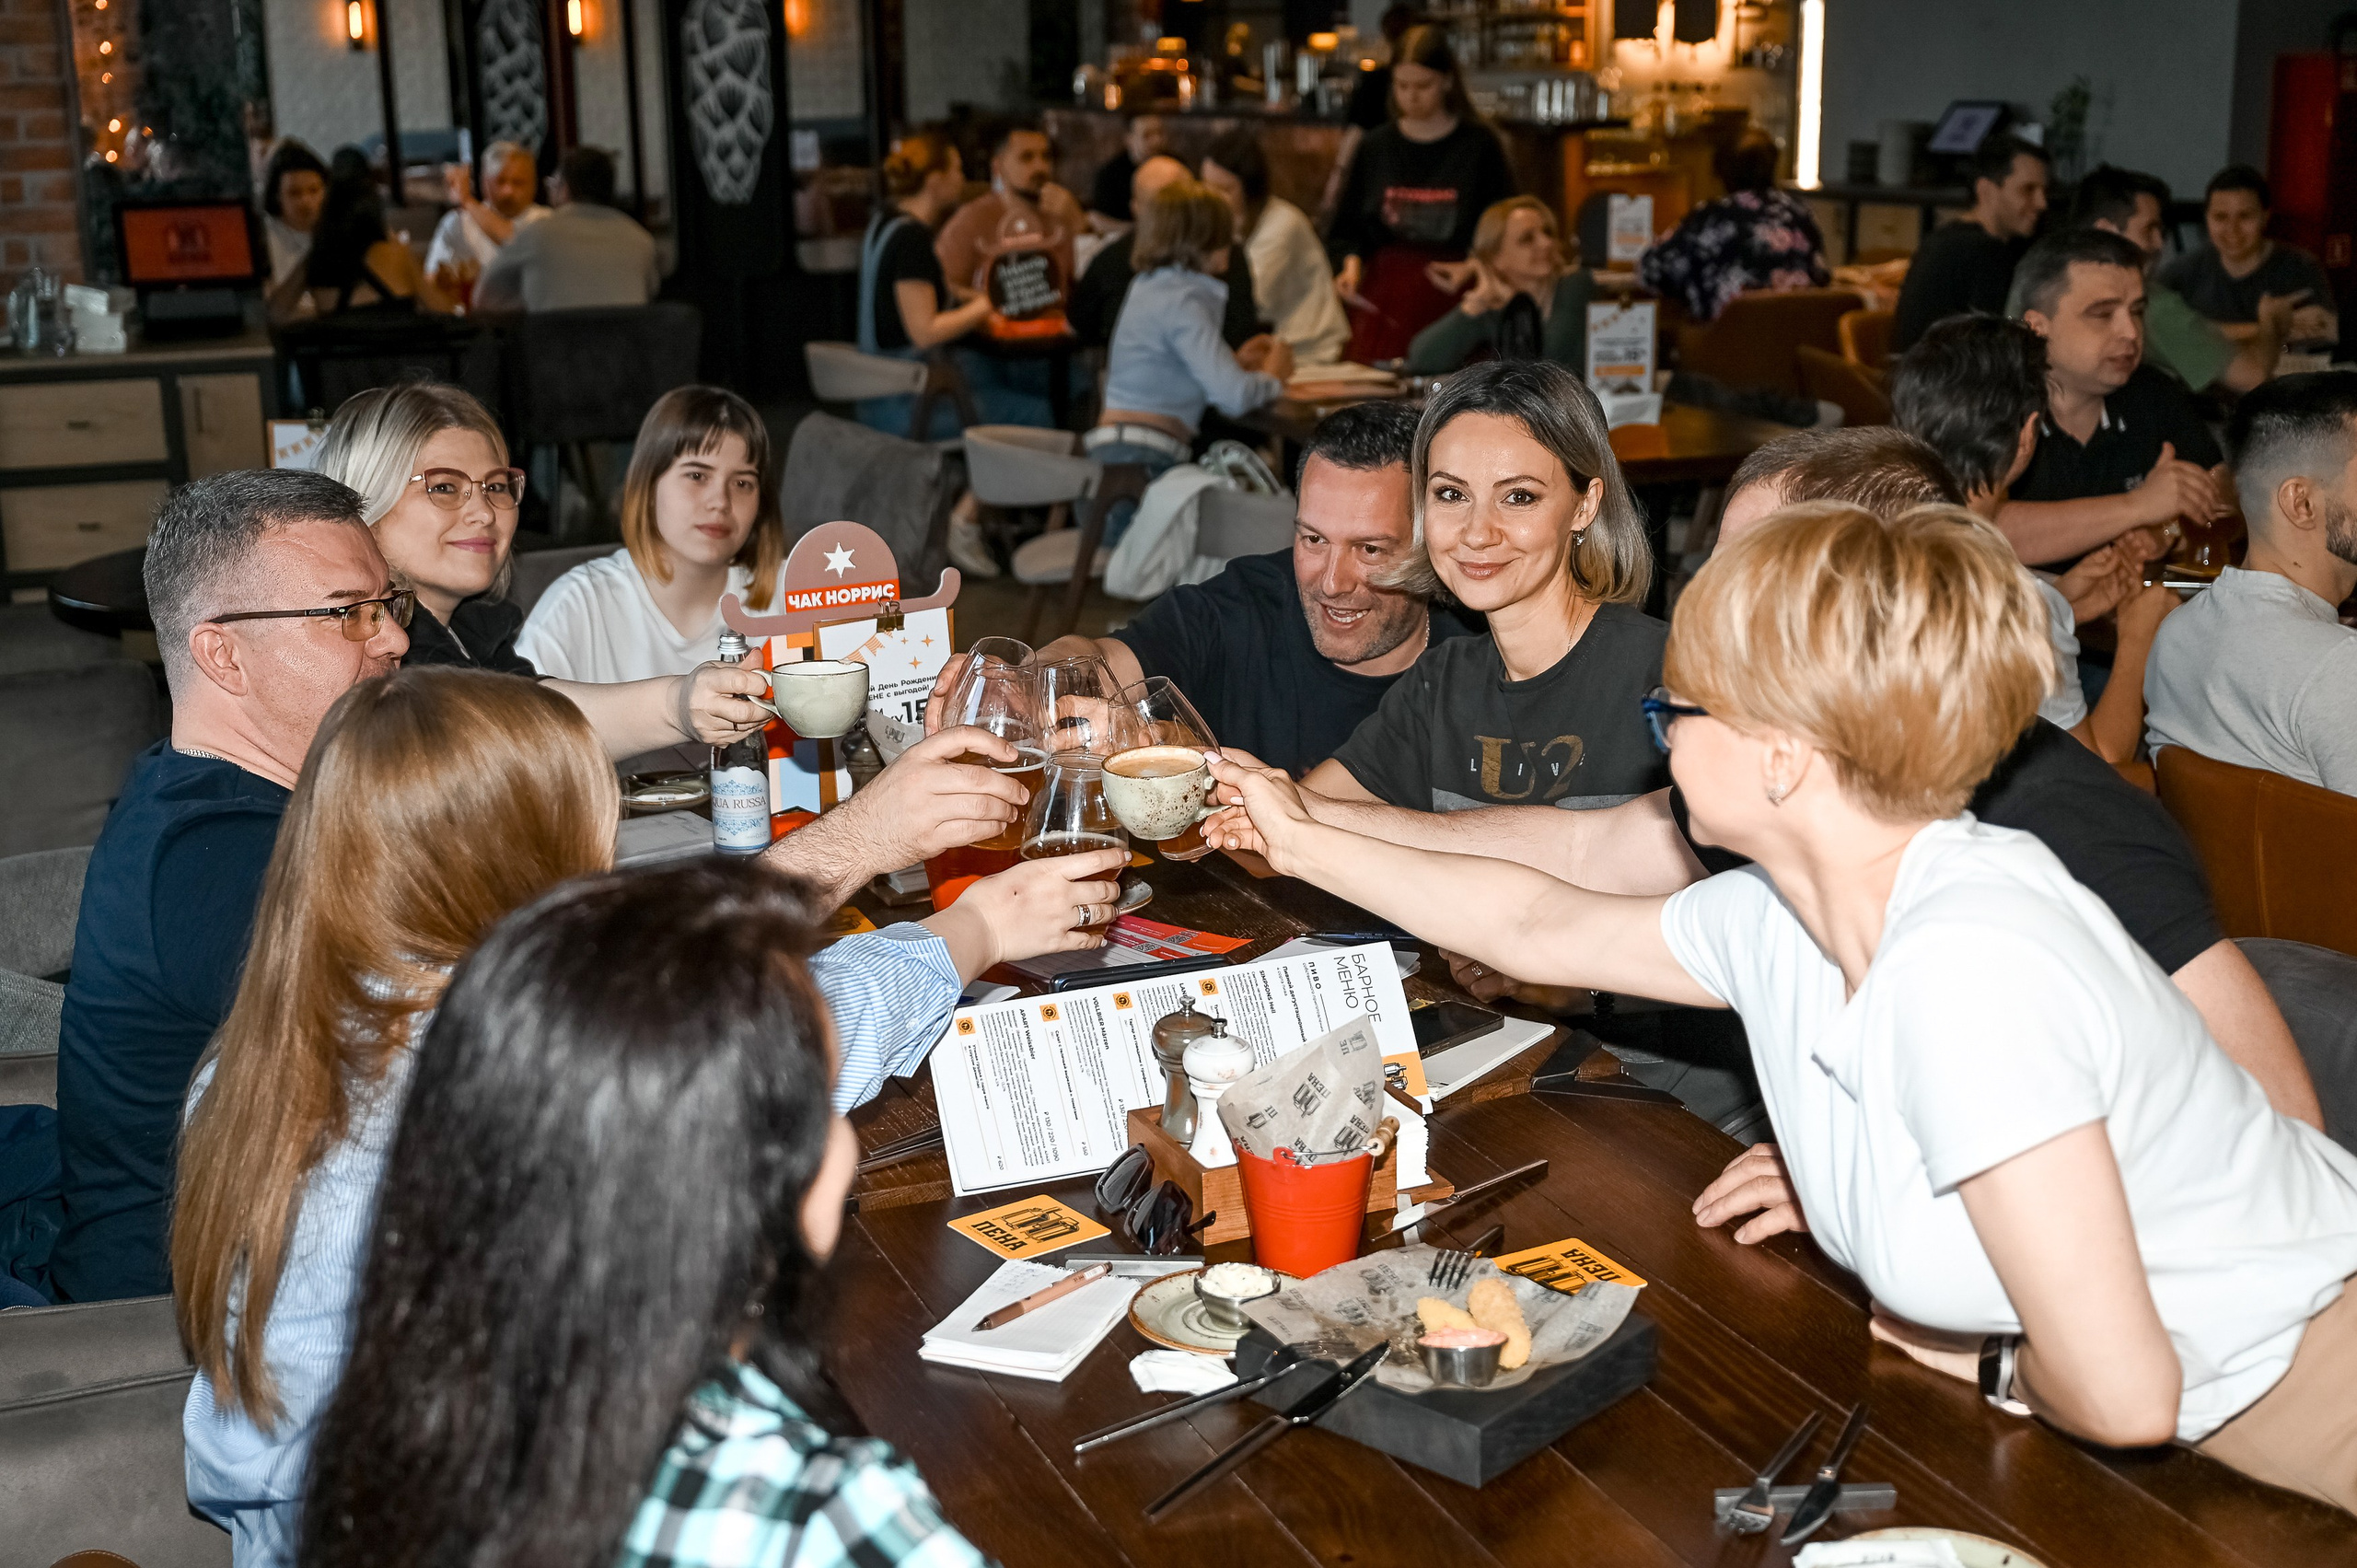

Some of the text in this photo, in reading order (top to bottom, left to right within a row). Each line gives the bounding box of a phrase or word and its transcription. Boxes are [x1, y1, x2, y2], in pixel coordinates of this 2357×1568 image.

[788, 584, 896, 609] ЧАК НОРРИС
[868, 693, 884, 702] ЕНЕ
[894, 684, 930, 697] выгодой!
[877, 682, 899, 691] День
[900, 674, 938, 687] Рождени
[713, 796, 766, 809] QUA RUSSA
[1259, 970, 1272, 1001] SIMPSONS
[1307, 961, 1321, 989] ПИВО
[1333, 956, 1358, 1008] МЕНЮ
[1351, 953, 1381, 1023] БАРНОЕ
[1092, 996, 1109, 1050] VOLLBIER Märzen
[1289, 990, 1306, 1042] дегустационный
[1018, 1008, 1035, 1059] APART Weissbier
[1306, 1072, 1332, 1099] ПЕНА
[970, 1220, 1028, 1251] ПЕНА
[1561, 1248, 1622, 1281] ПЕНА
